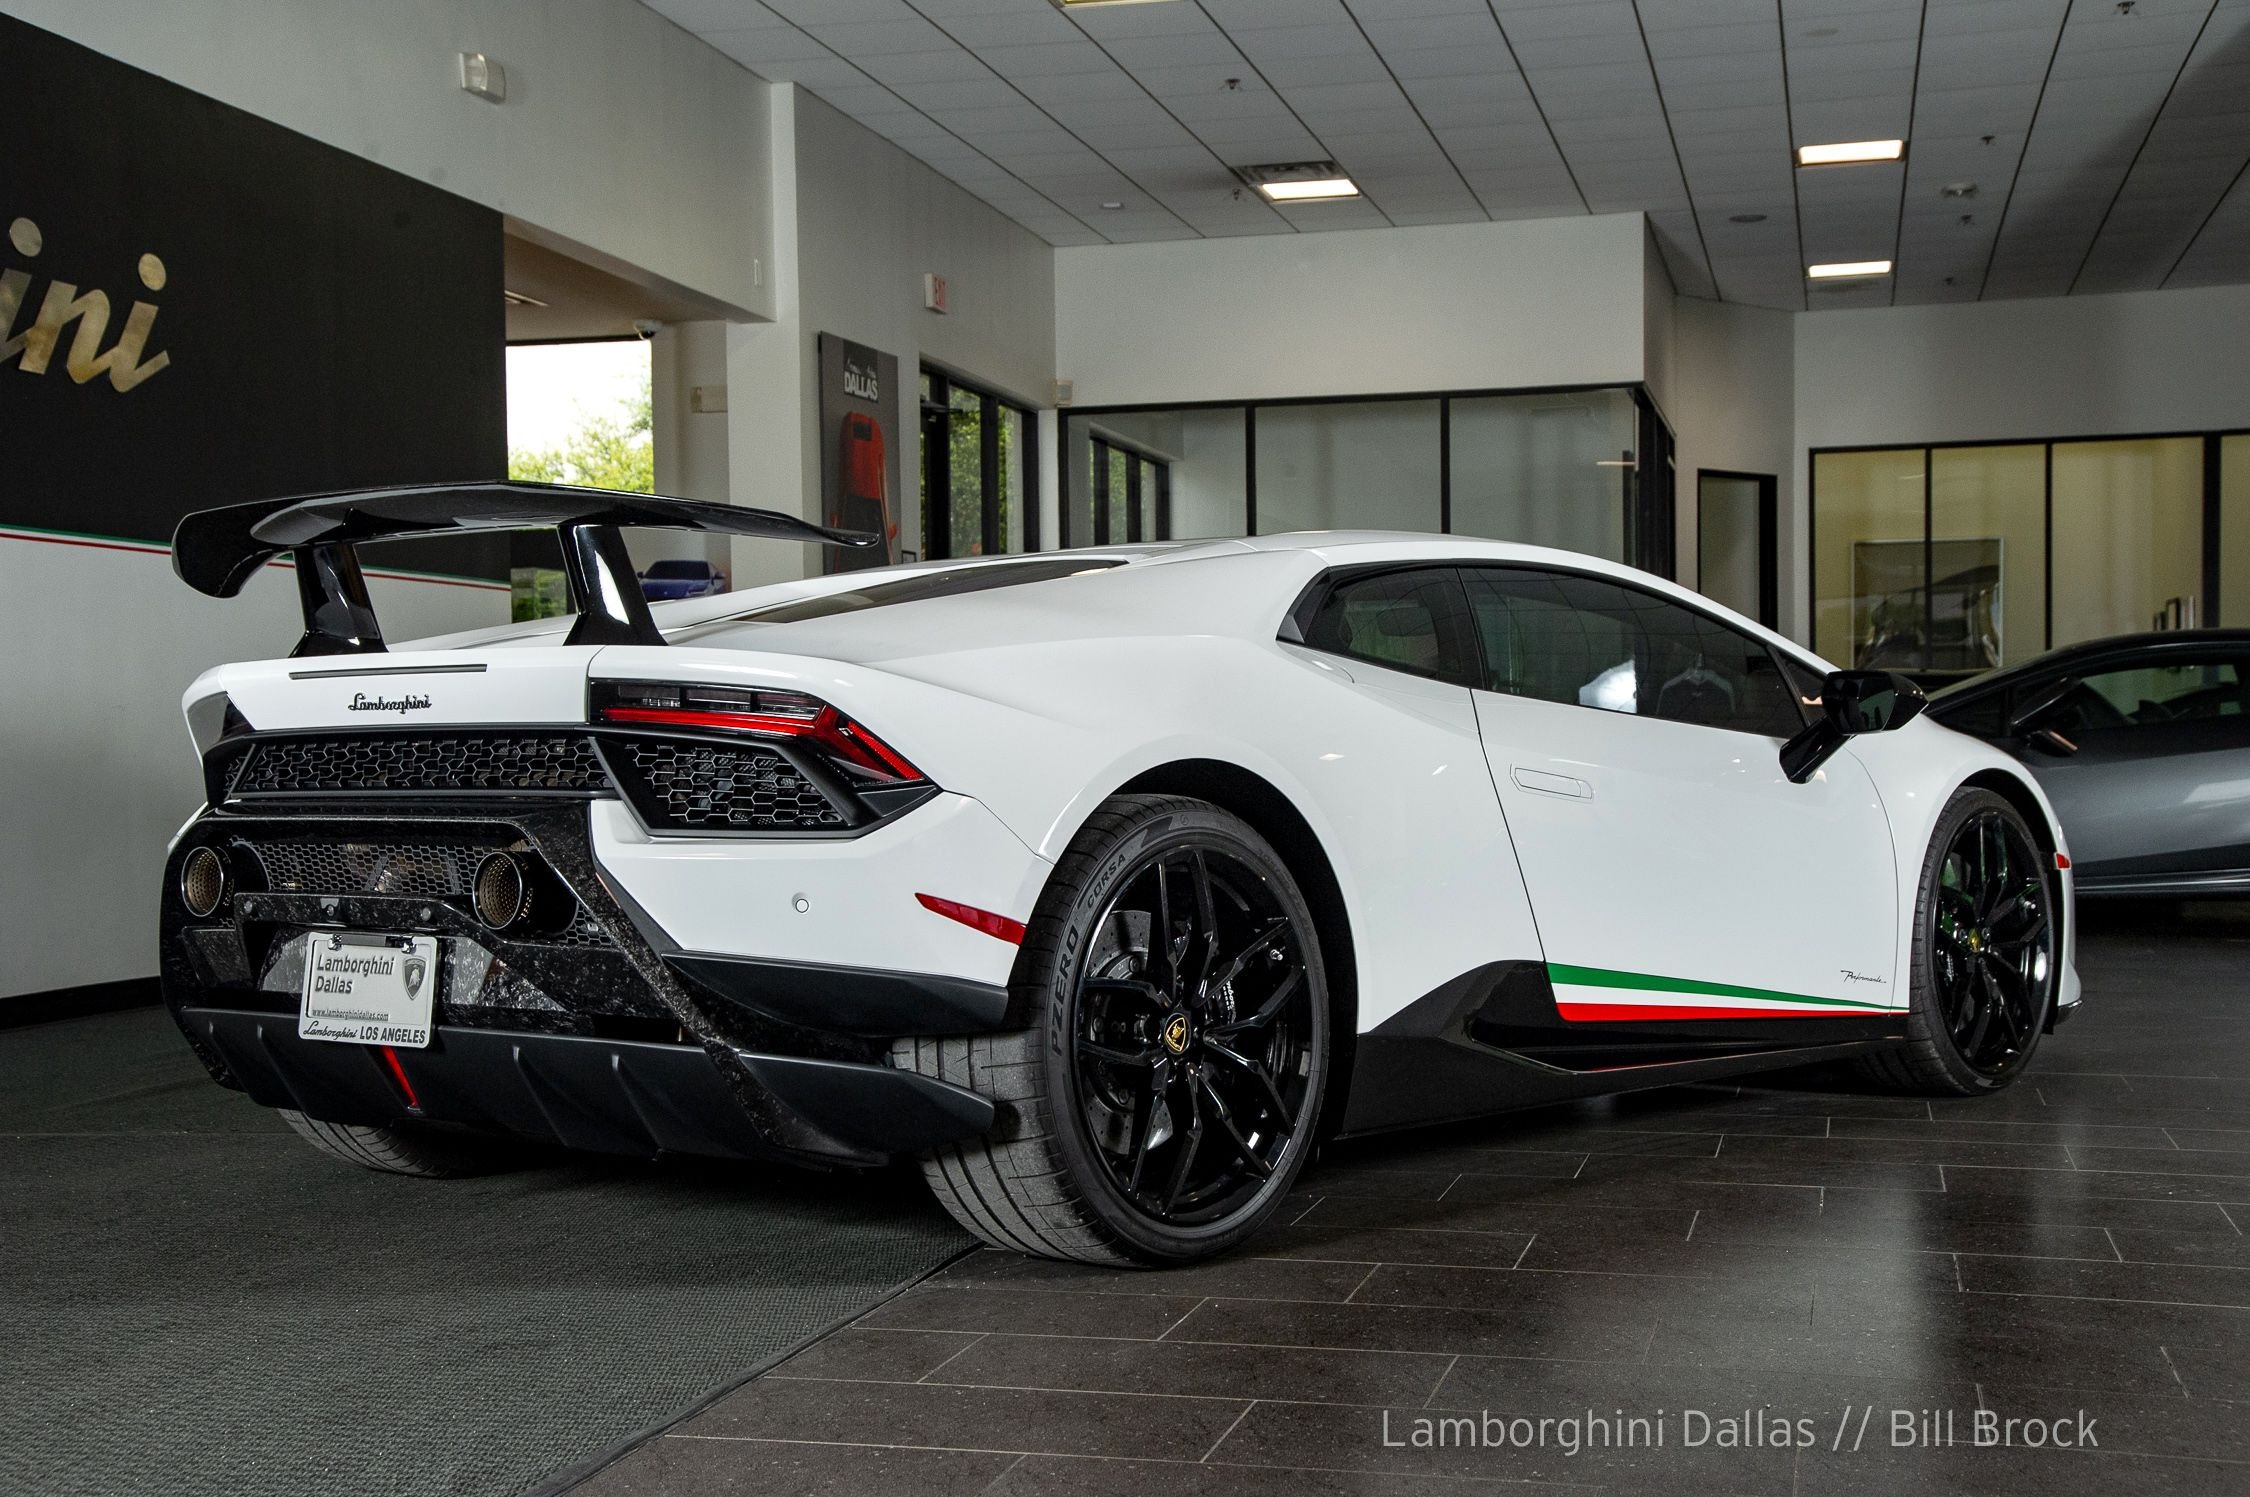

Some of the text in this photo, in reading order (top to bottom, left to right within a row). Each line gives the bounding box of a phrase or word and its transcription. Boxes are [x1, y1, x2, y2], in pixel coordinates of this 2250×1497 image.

[844, 370, 878, 401] DALLAS
[348, 692, 432, 714] Lamborghini
[1086, 853, 1126, 909] CORSA
[316, 954, 395, 977] Lamborghini
[315, 975, 353, 994] Dallas
[312, 1009, 389, 1021] www.lamborghinidallas.com
[302, 1020, 426, 1044] Lamborghini LOS ANGELES
